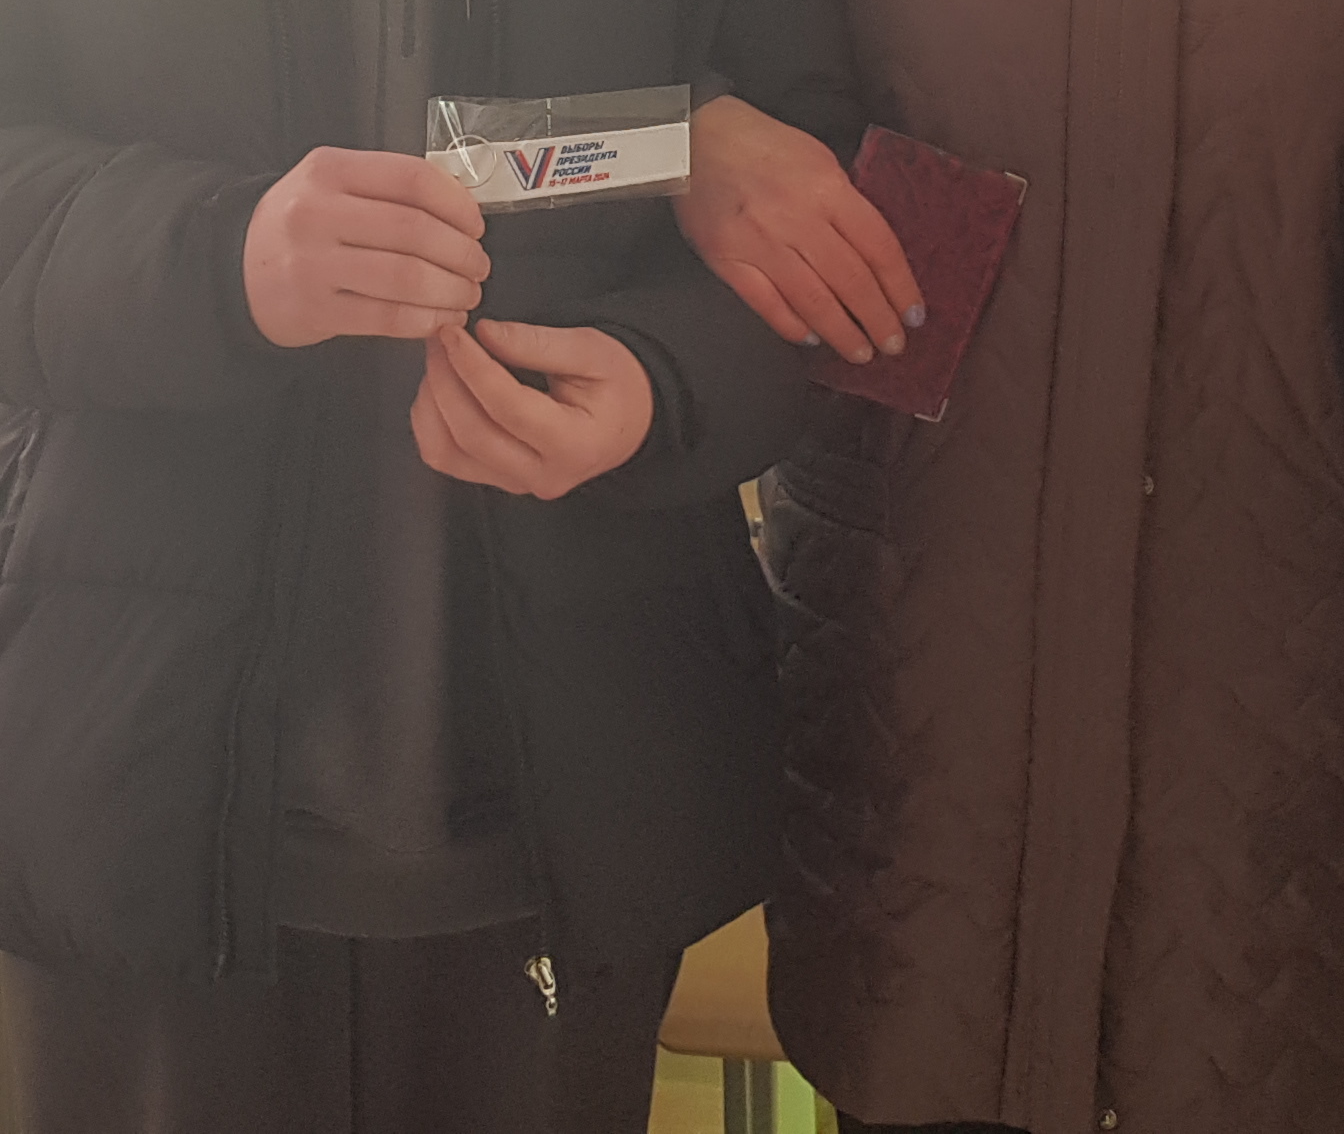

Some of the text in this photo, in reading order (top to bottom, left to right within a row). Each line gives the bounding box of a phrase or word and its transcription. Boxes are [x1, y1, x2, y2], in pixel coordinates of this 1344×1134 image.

[560, 140, 605, 155] ВЫБОРЫ
[556, 150, 618, 166] ПРЕЗИДЕНТА
[552, 165, 592, 178] РОССИИ
[568, 174, 592, 185] МАРТА
